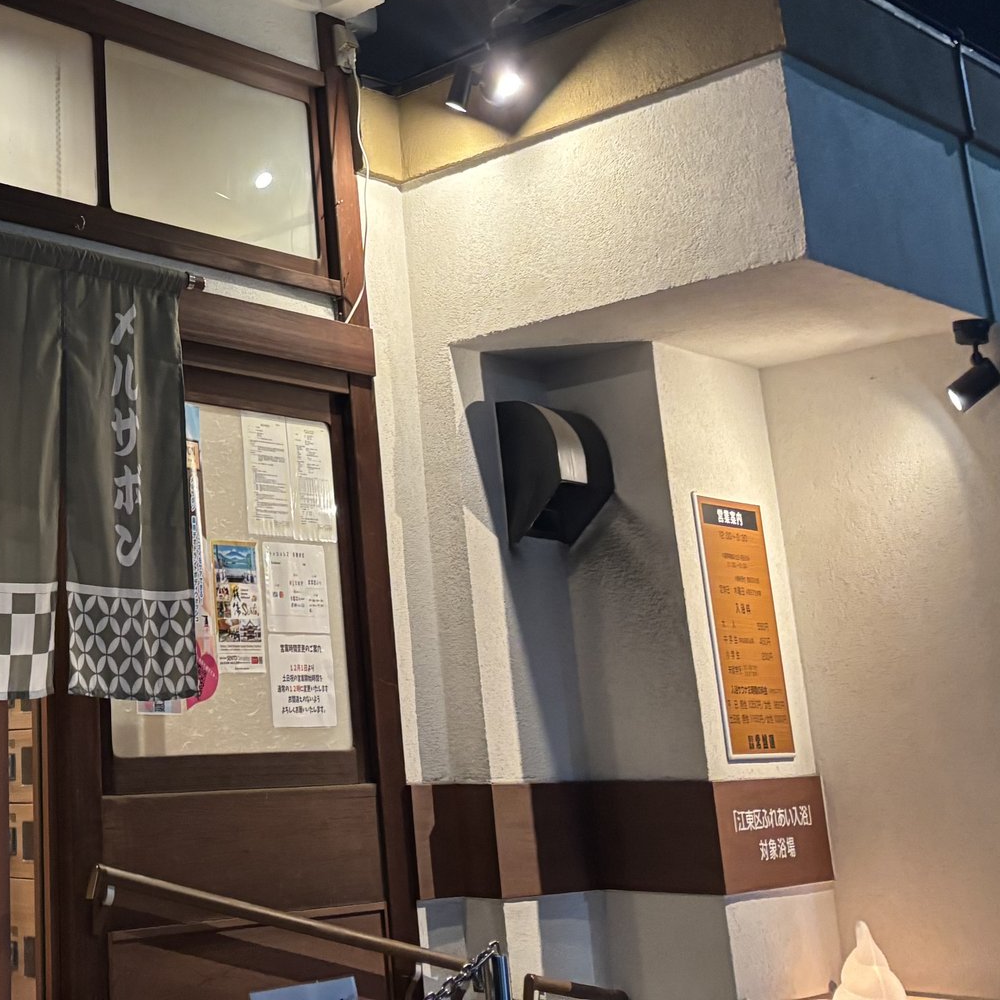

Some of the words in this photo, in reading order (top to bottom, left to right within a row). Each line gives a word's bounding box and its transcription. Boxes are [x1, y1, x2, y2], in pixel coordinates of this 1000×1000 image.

[110, 303, 143, 568] メルサボン
[733, 804, 813, 833] 「江東区ふれあい入浴」
[758, 836, 797, 861] 対象浴場
